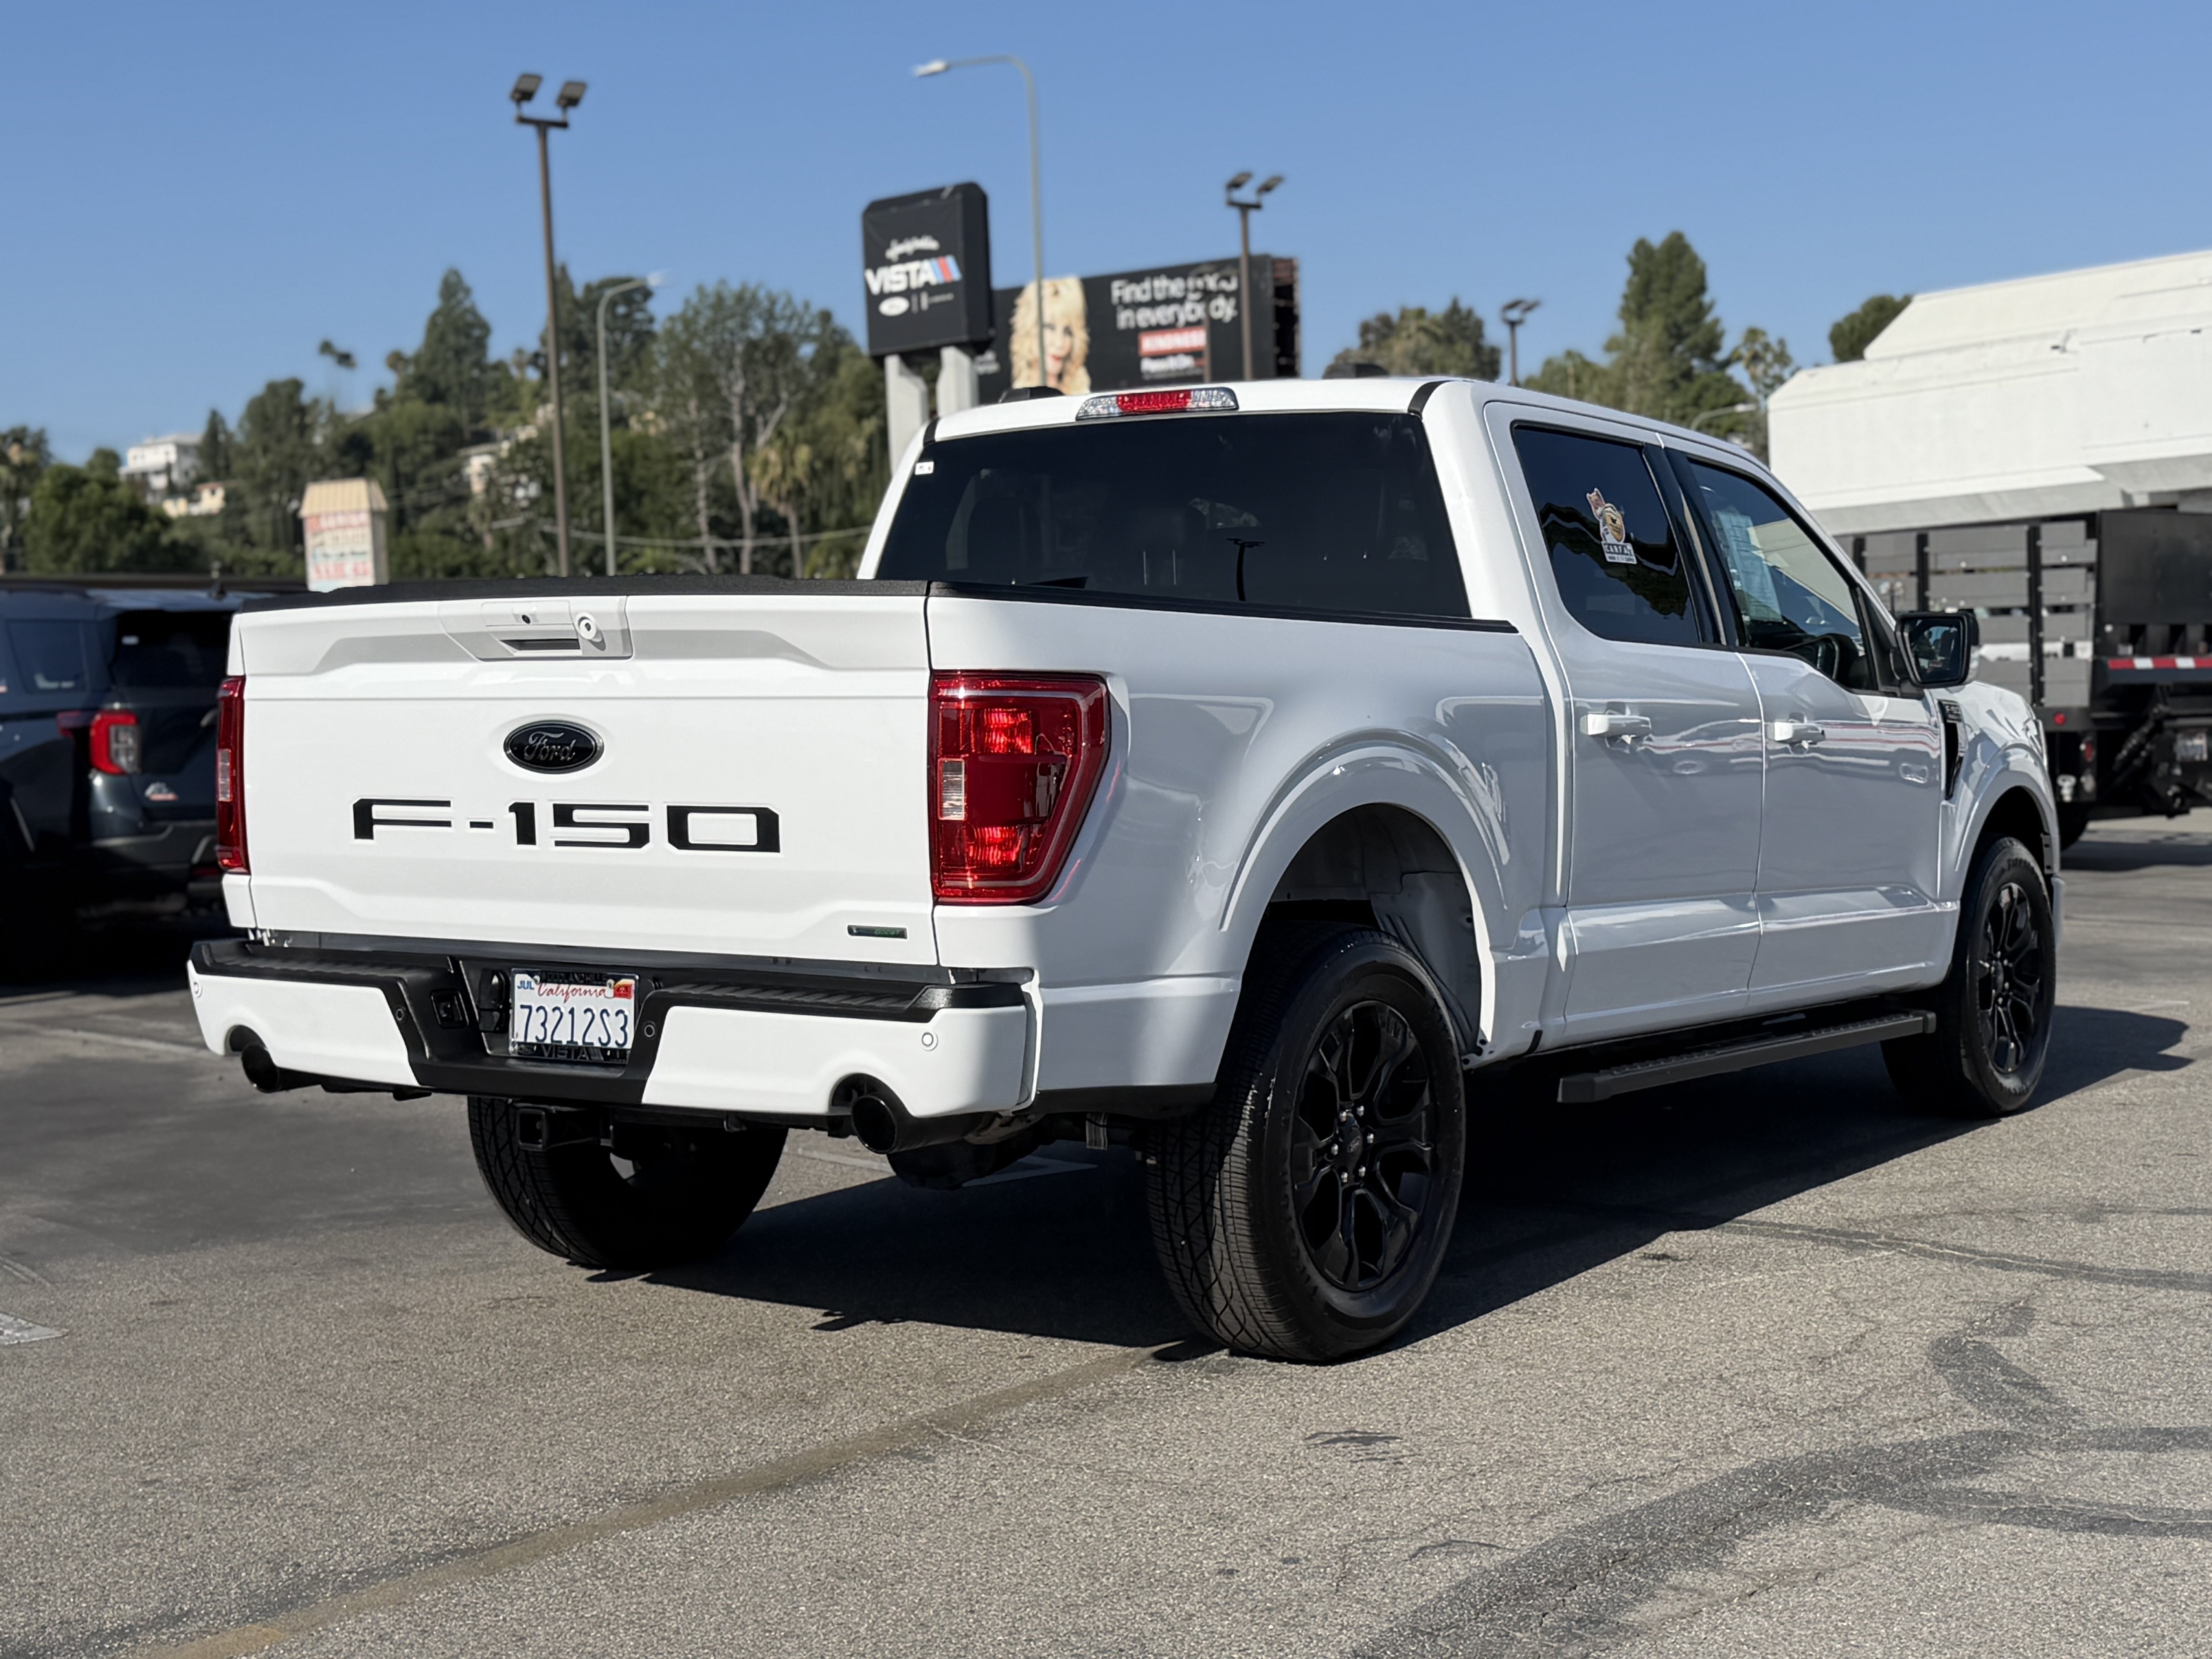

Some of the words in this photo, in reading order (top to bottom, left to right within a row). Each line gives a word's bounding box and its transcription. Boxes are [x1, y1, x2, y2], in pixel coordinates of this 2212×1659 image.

[865, 258, 938, 295] VISTA
[1111, 276, 1152, 306] Find
[1152, 273, 1186, 301] the
[1116, 304, 1136, 330] in
[524, 731, 576, 761] Ford
[352, 798, 781, 853] F-150
[517, 980, 535, 990] JUL
[538, 982, 606, 1003] California
[520, 1004, 628, 1047] 73212S3
